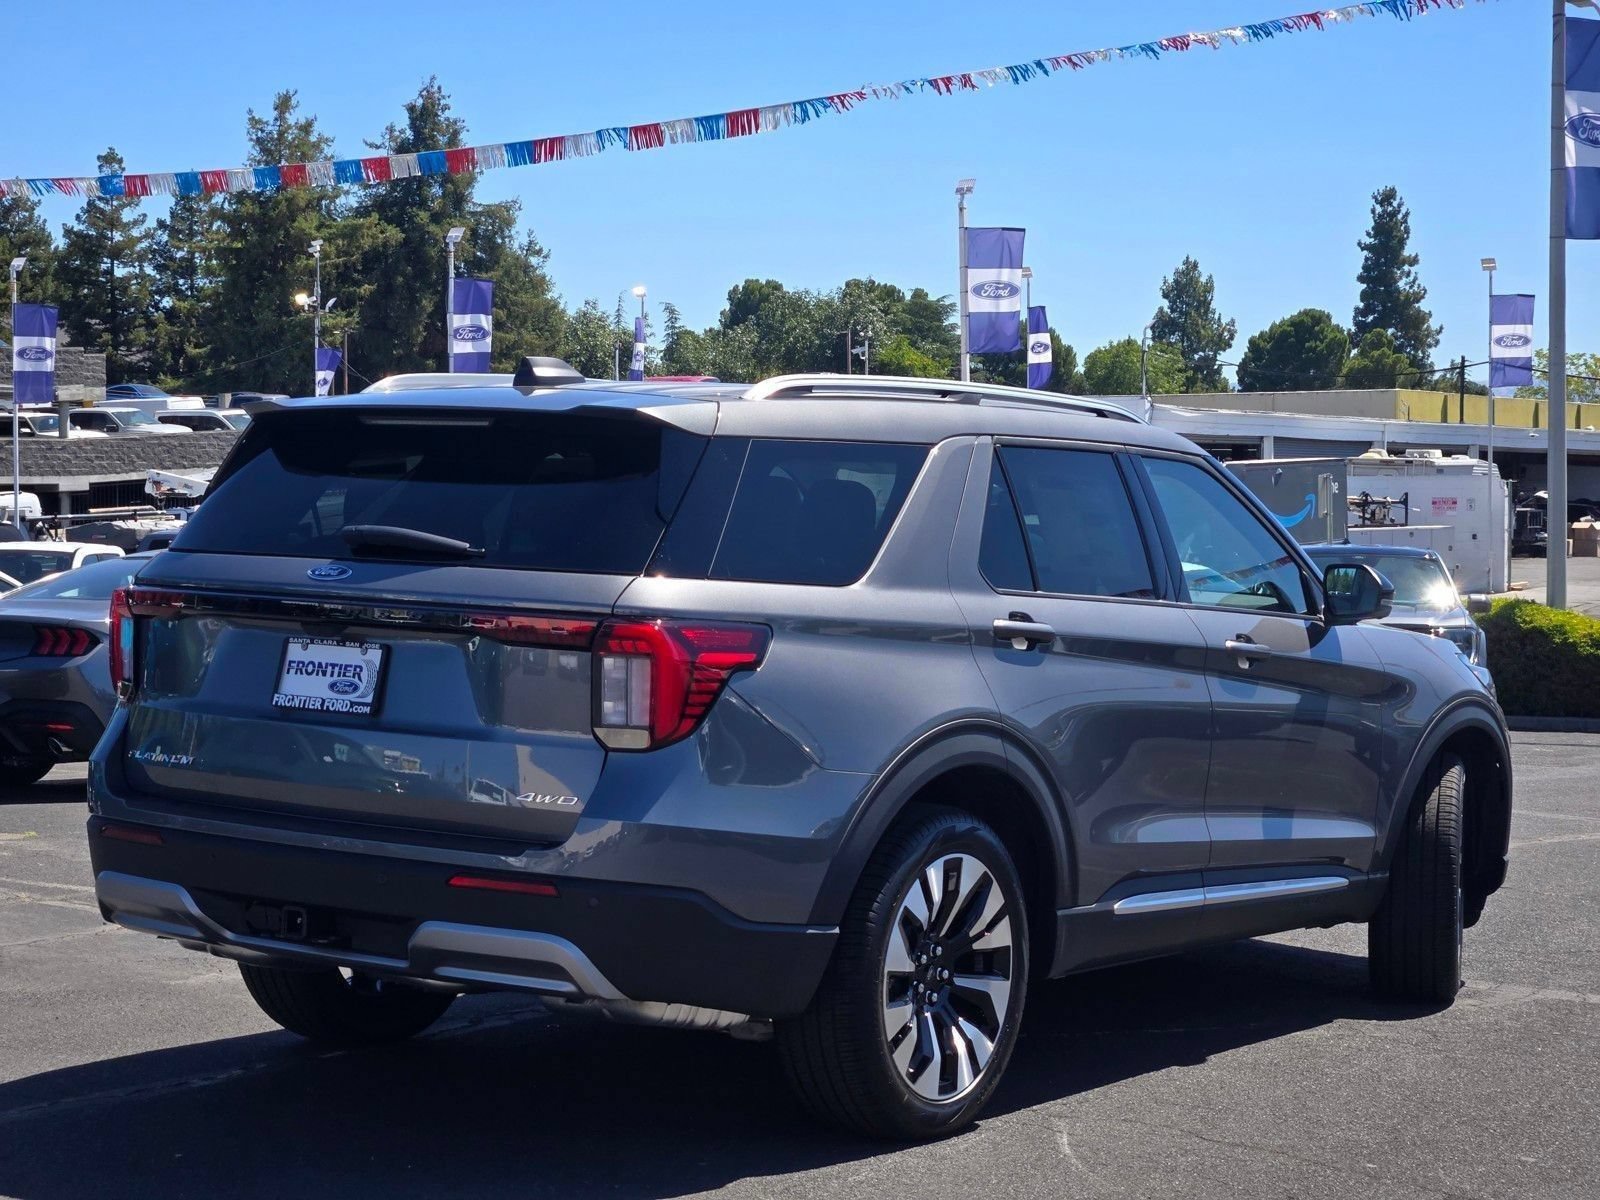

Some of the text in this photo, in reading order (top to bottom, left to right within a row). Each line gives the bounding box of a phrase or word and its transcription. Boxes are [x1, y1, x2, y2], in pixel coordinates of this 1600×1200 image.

[980, 282, 1011, 297] Ford
[456, 326, 484, 340] Ford
[1500, 335, 1525, 346] Ford
[23, 346, 47, 359] Ford
[313, 638, 338, 646] CLARA
[345, 640, 360, 648] SAN
[362, 641, 381, 650] JOSE
[286, 659, 364, 684] FRONTIER
[272, 693, 323, 710] FRONTIER
[516, 792, 579, 805] 4WD
